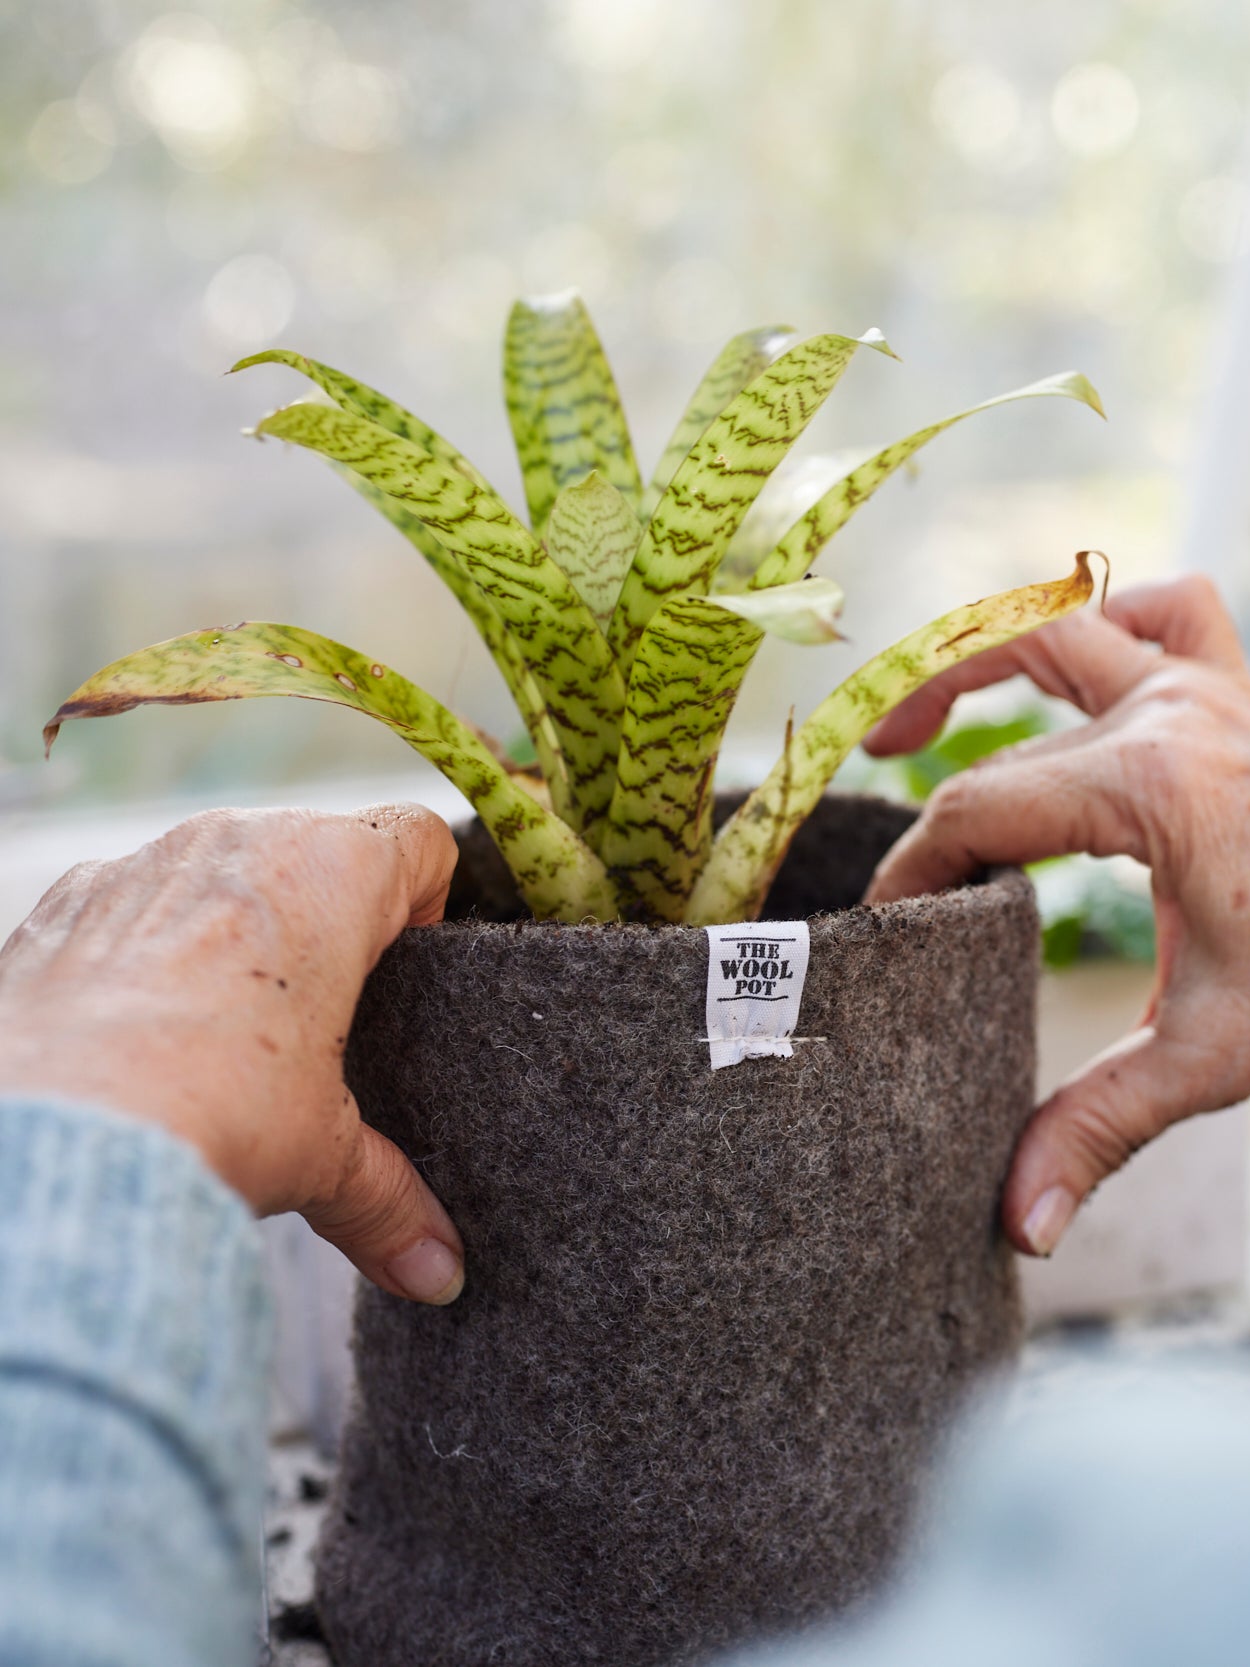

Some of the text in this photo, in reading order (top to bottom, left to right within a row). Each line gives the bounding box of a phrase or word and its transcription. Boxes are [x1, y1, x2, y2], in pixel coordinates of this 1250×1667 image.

[737, 943, 780, 959] THE
[720, 959, 793, 979] WOOL
[735, 979, 776, 995] POT
